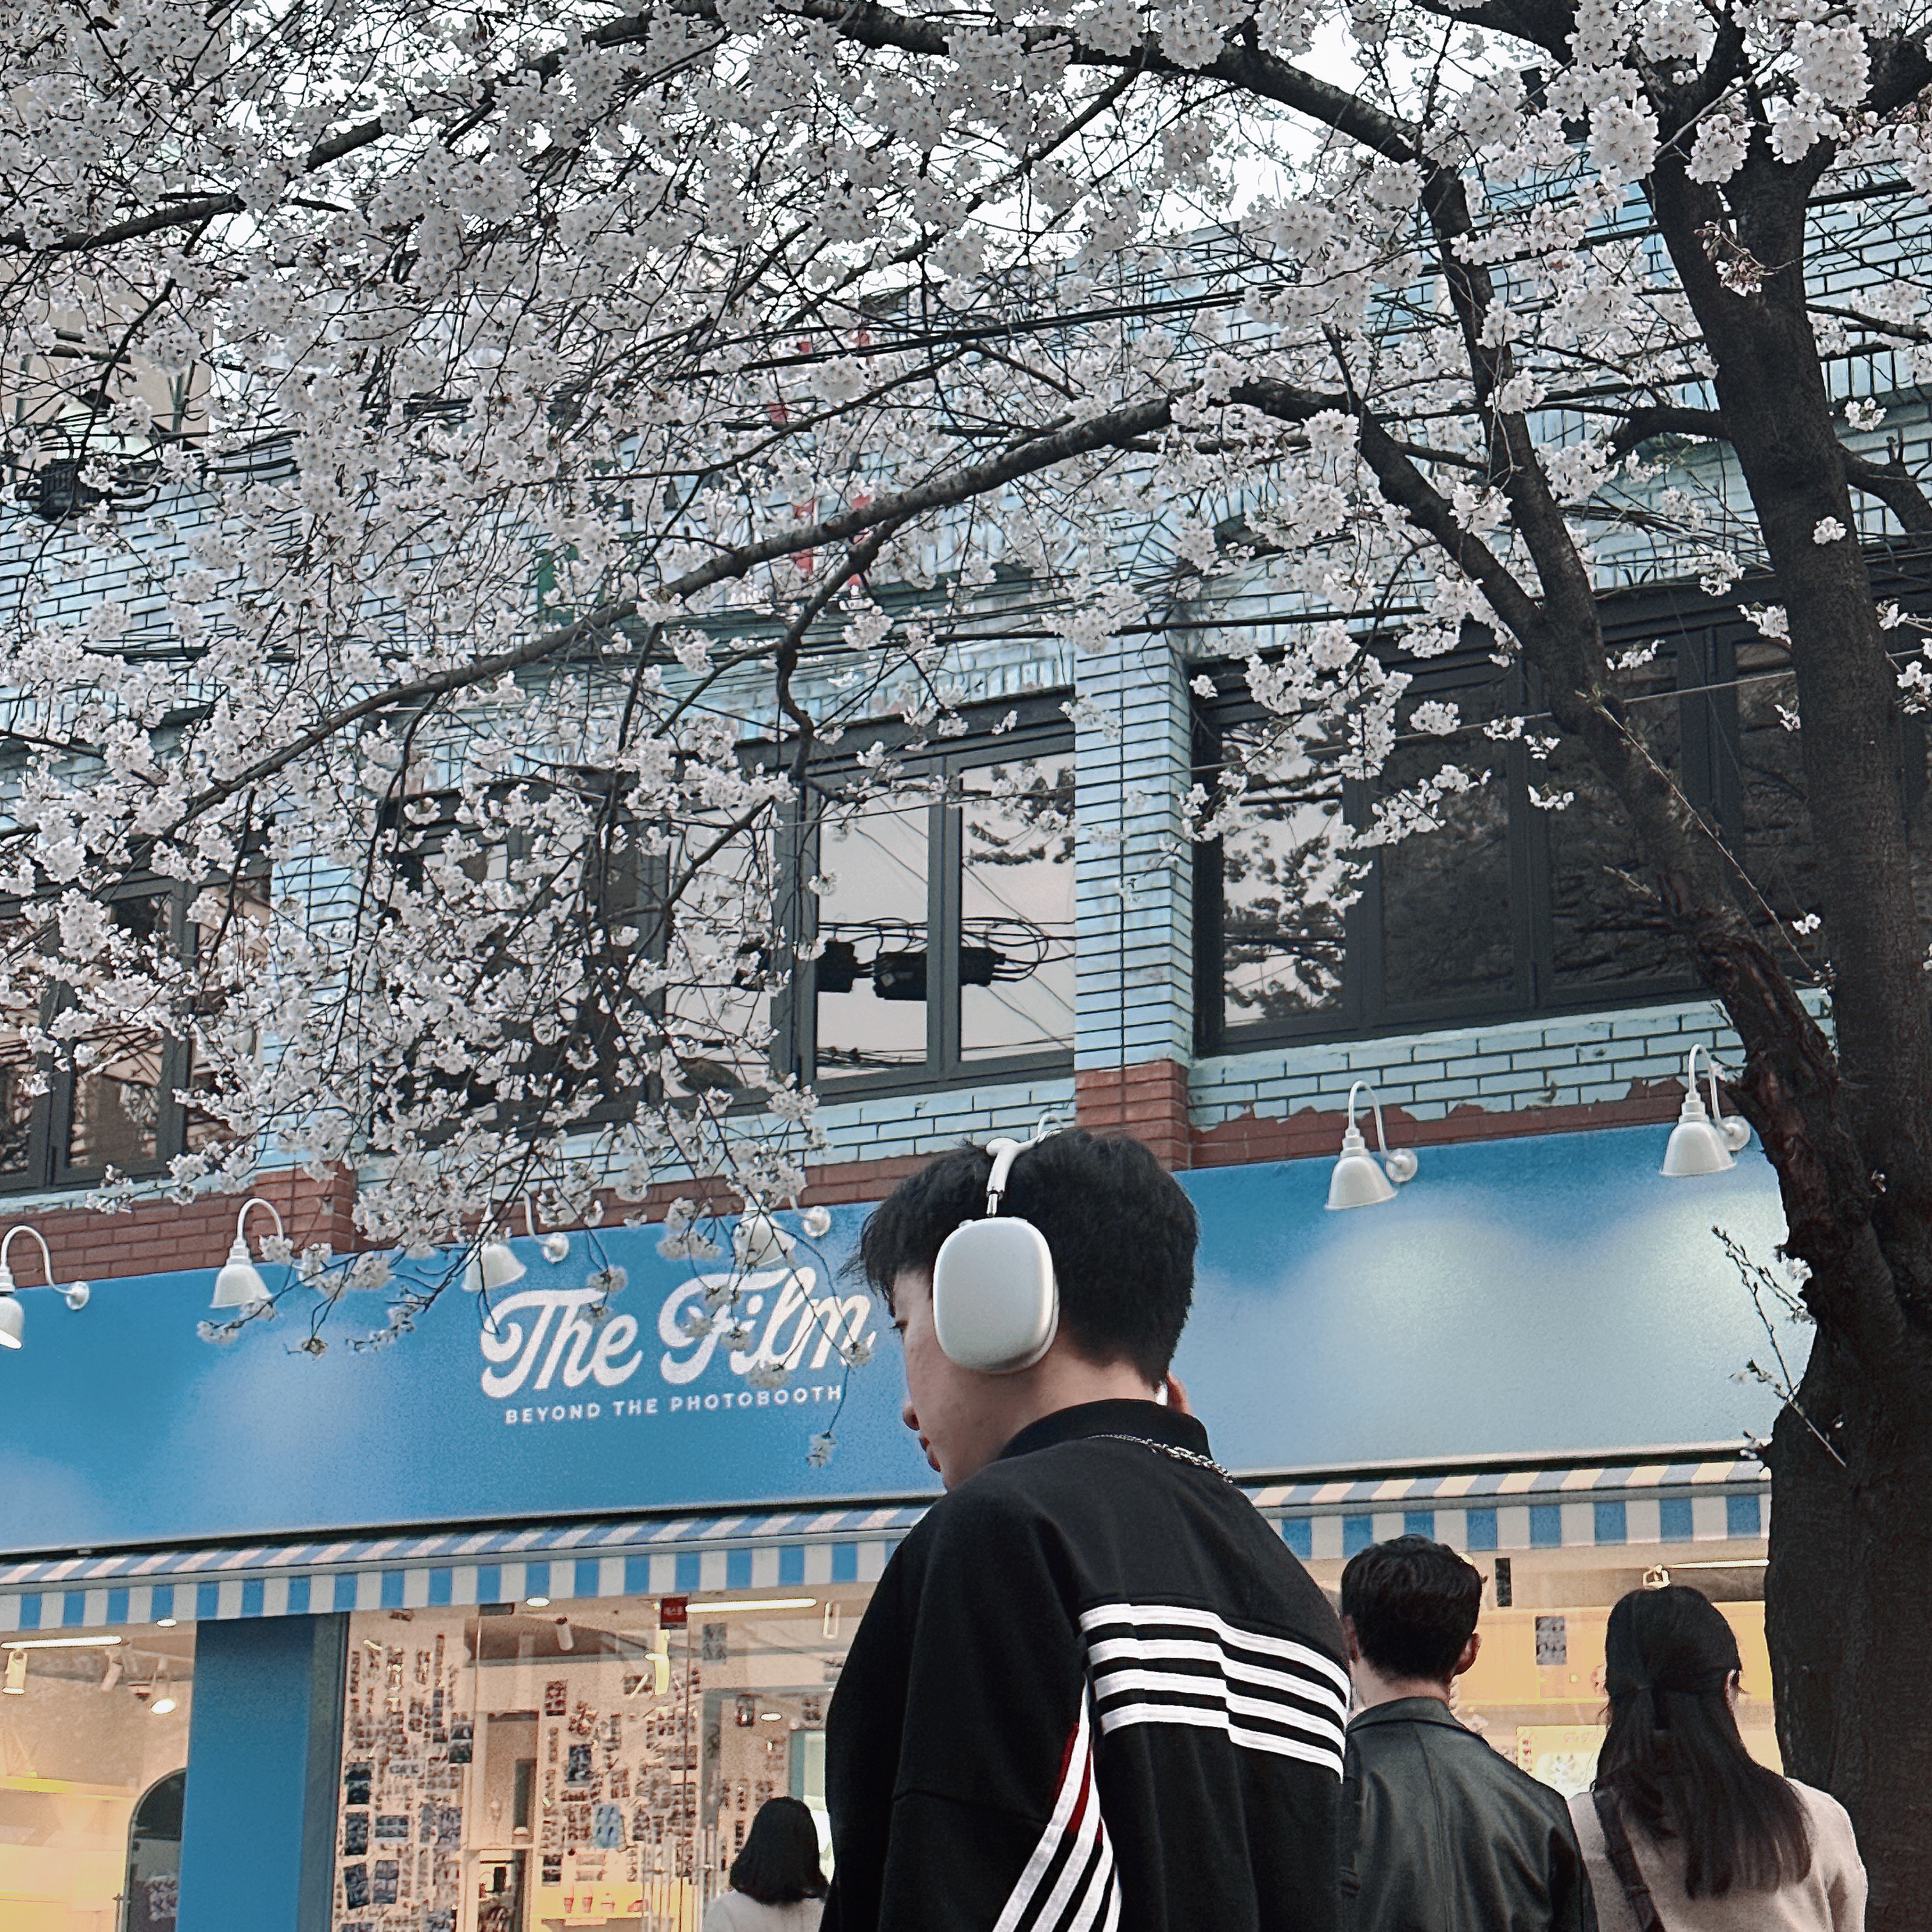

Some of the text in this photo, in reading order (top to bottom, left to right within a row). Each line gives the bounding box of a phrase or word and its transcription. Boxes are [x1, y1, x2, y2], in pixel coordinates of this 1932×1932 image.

[480, 1266, 877, 1398] The Film
[505, 1384, 842, 1425] BEYOND THE PHOTOBOOTH
